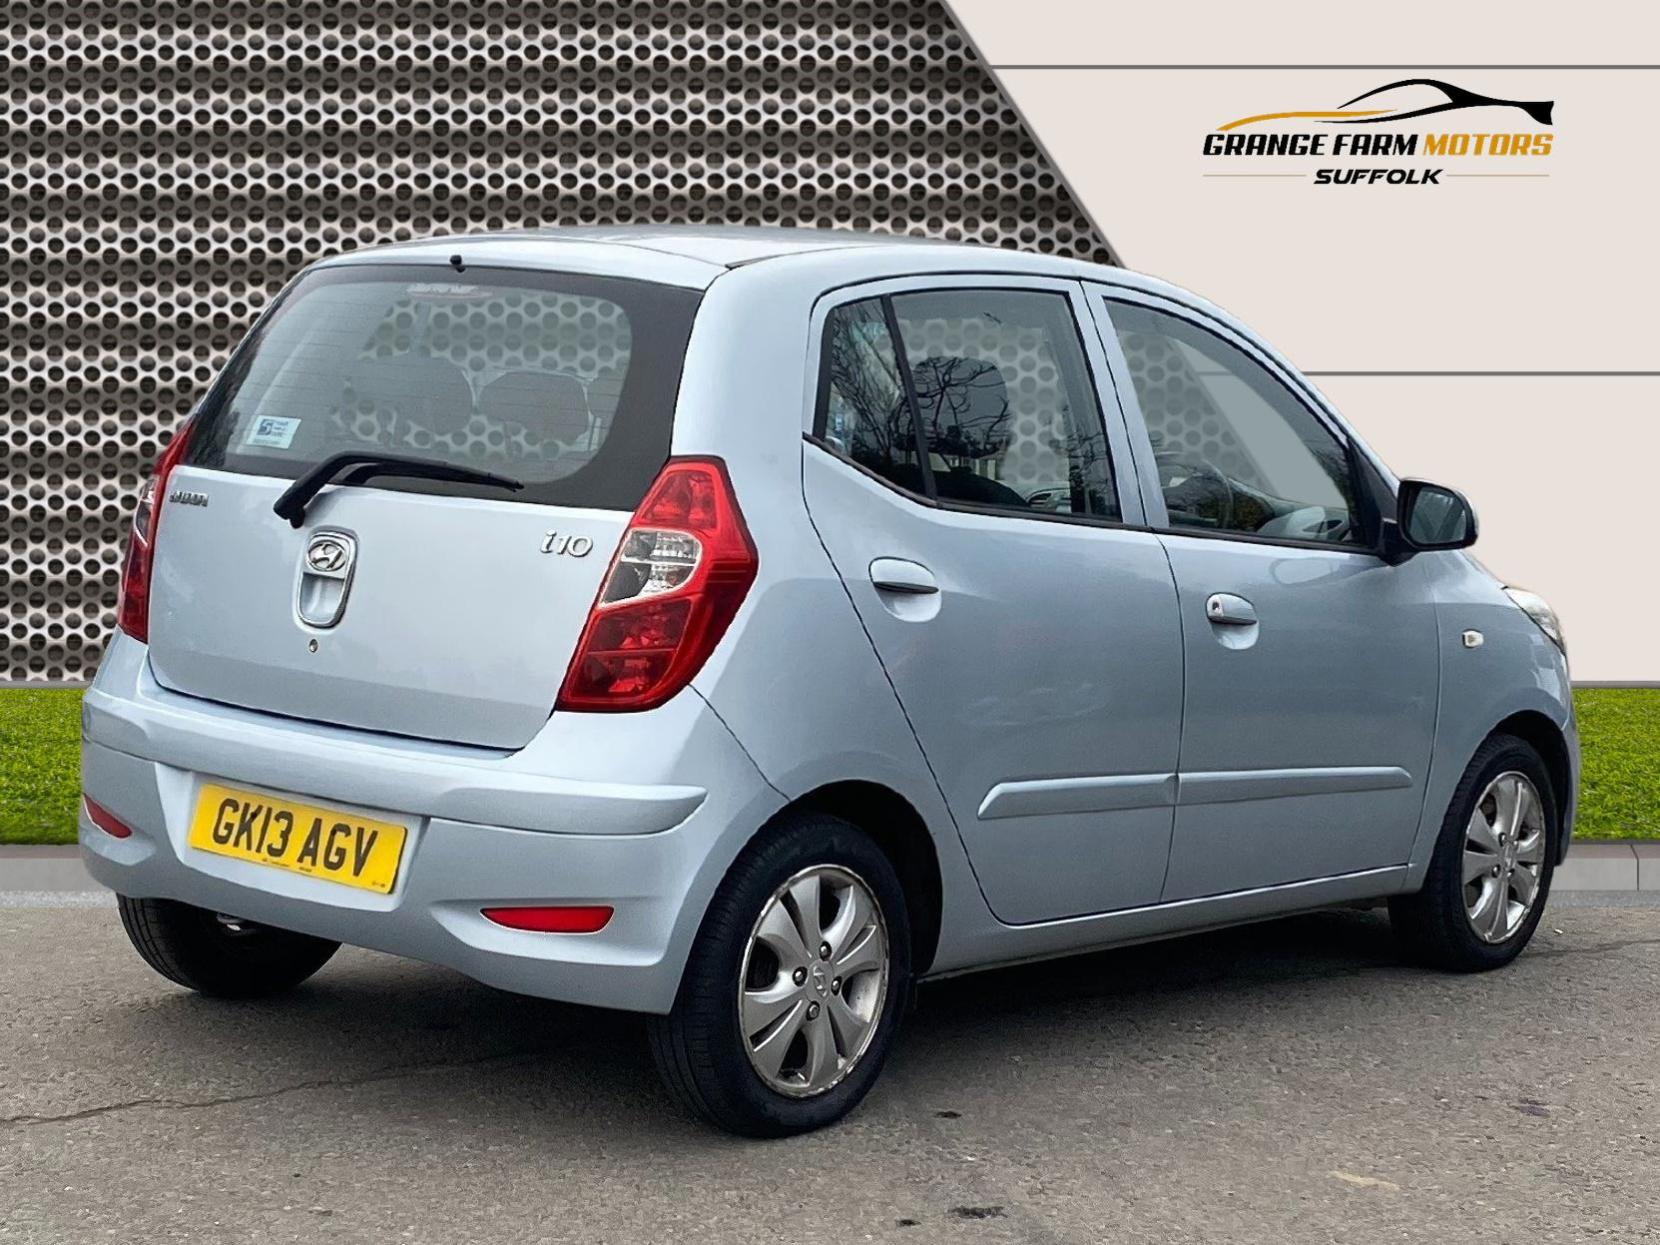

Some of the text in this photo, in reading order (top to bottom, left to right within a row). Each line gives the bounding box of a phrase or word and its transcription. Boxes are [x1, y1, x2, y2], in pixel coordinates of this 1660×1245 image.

[540, 529, 594, 558] i10
[212, 798, 378, 877] GK13 AGV
